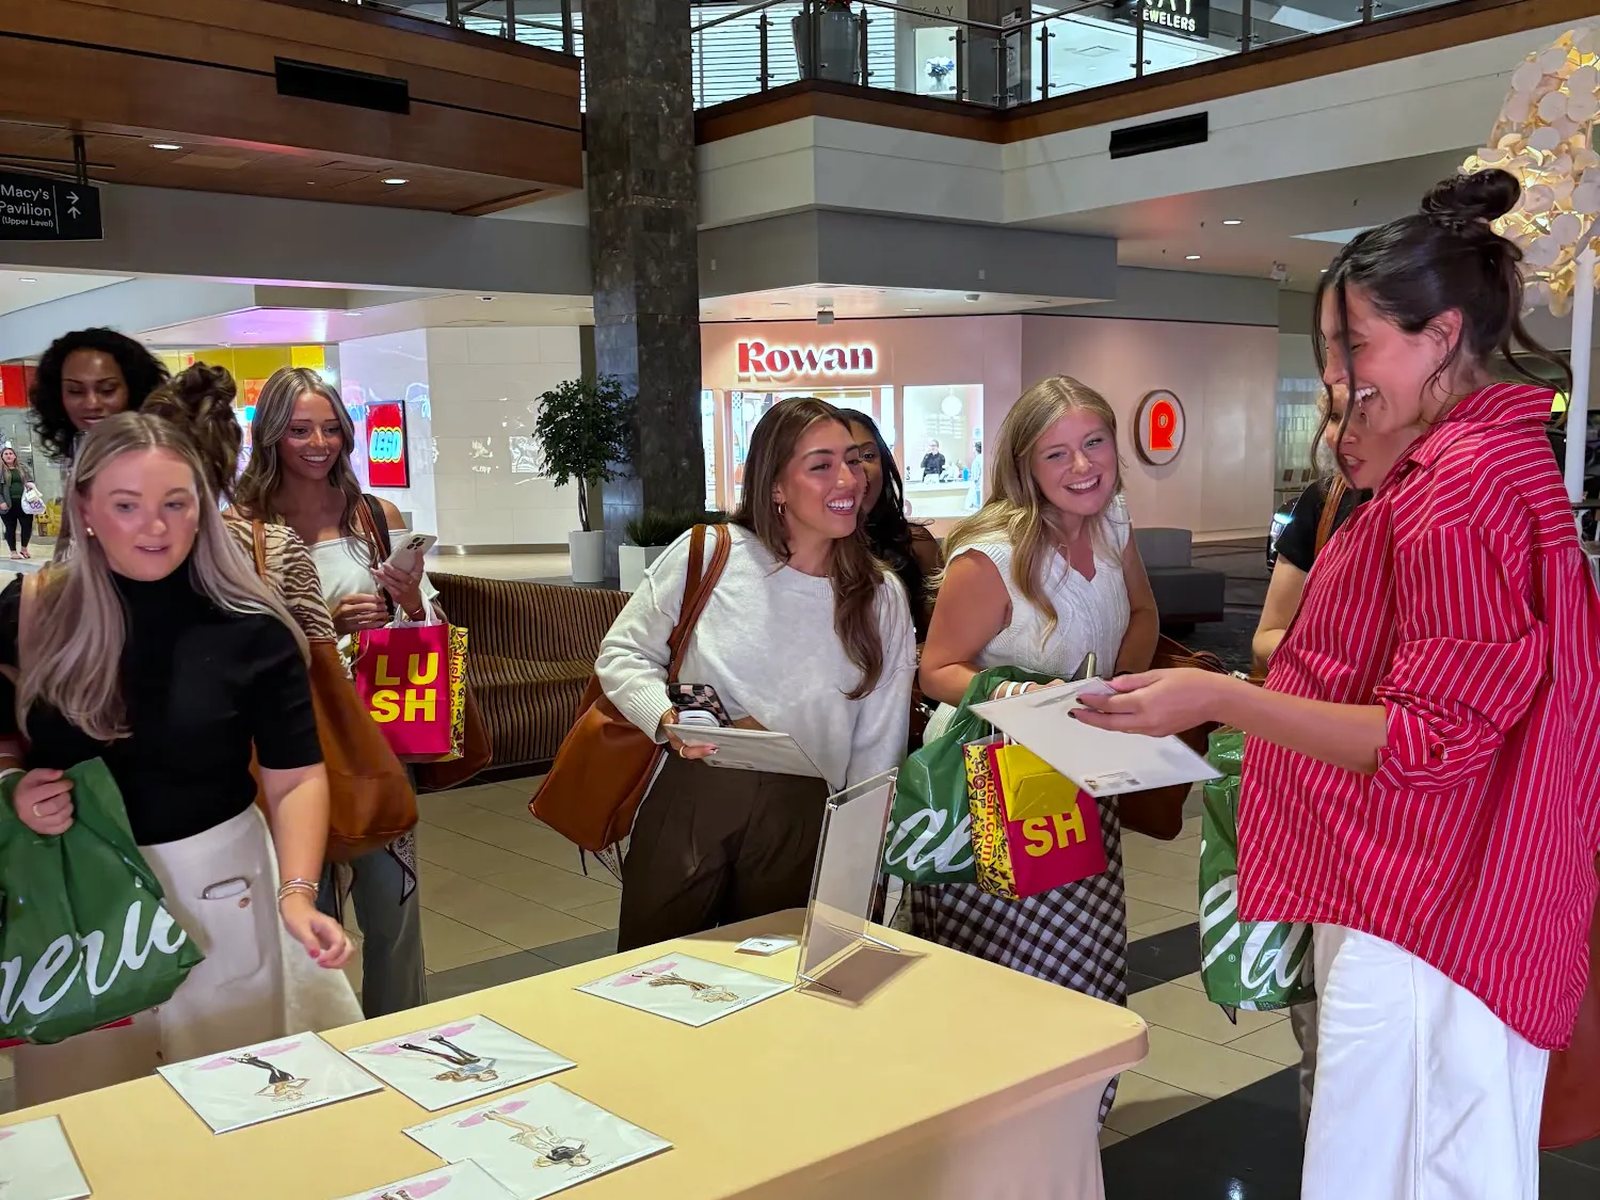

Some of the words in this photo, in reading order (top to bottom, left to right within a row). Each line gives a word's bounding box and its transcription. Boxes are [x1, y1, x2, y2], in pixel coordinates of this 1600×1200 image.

[1142, 9, 1196, 32] EWELERS
[1, 184, 50, 201] Macy's
[0, 201, 51, 216] Pavilion
[2, 216, 28, 226] (Upper
[30, 218, 54, 228] Level)
[737, 341, 874, 374] Rowan
[1150, 400, 1177, 451] R
